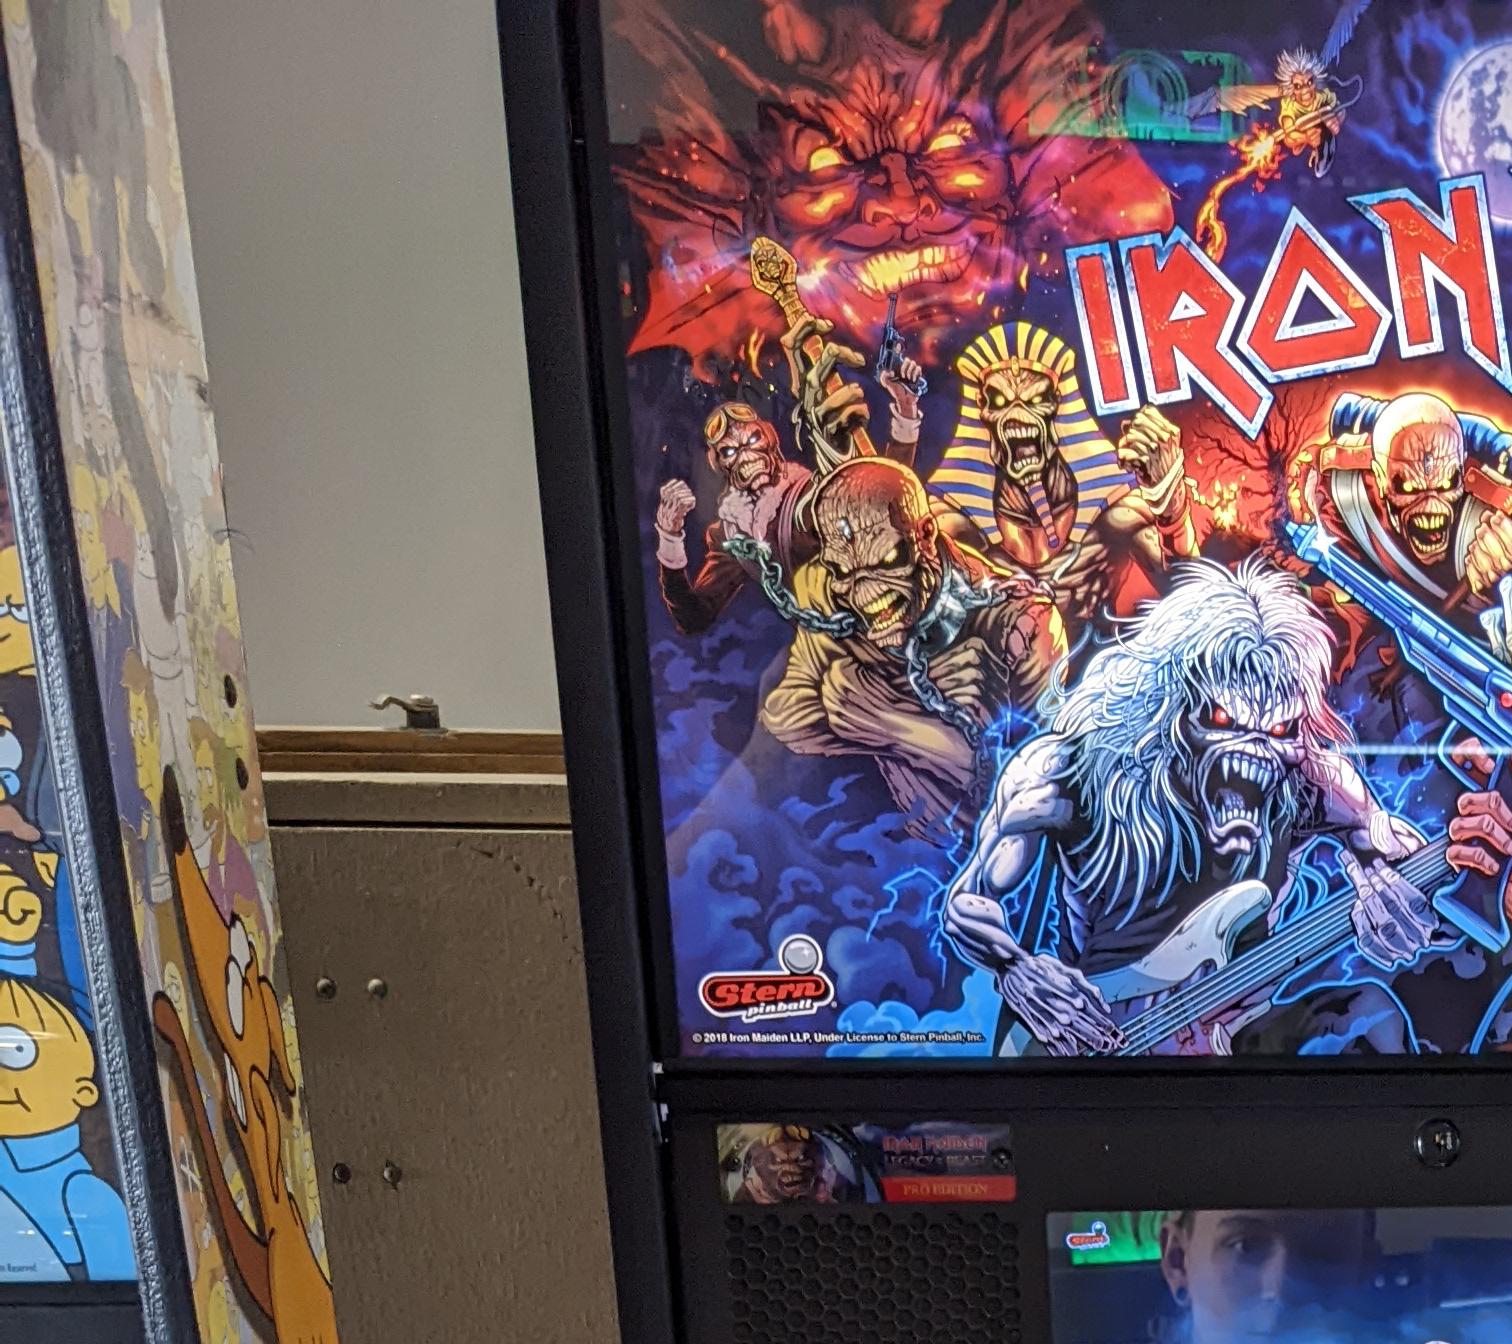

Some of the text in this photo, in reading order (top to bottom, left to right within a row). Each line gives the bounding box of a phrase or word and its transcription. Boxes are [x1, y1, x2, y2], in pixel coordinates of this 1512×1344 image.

[714, 981, 824, 1008] Stern
[746, 999, 813, 1018] pinball
[703, 1033, 728, 1044] 2018
[729, 1033, 750, 1044] Iron
[752, 1033, 788, 1044] Maiden
[790, 1033, 812, 1045] LLP,
[814, 1033, 845, 1044] Under
[846, 1033, 885, 1044] License
[886, 1033, 898, 1044] to
[900, 1033, 927, 1044] Stern
[966, 1033, 986, 1044] Inc.
